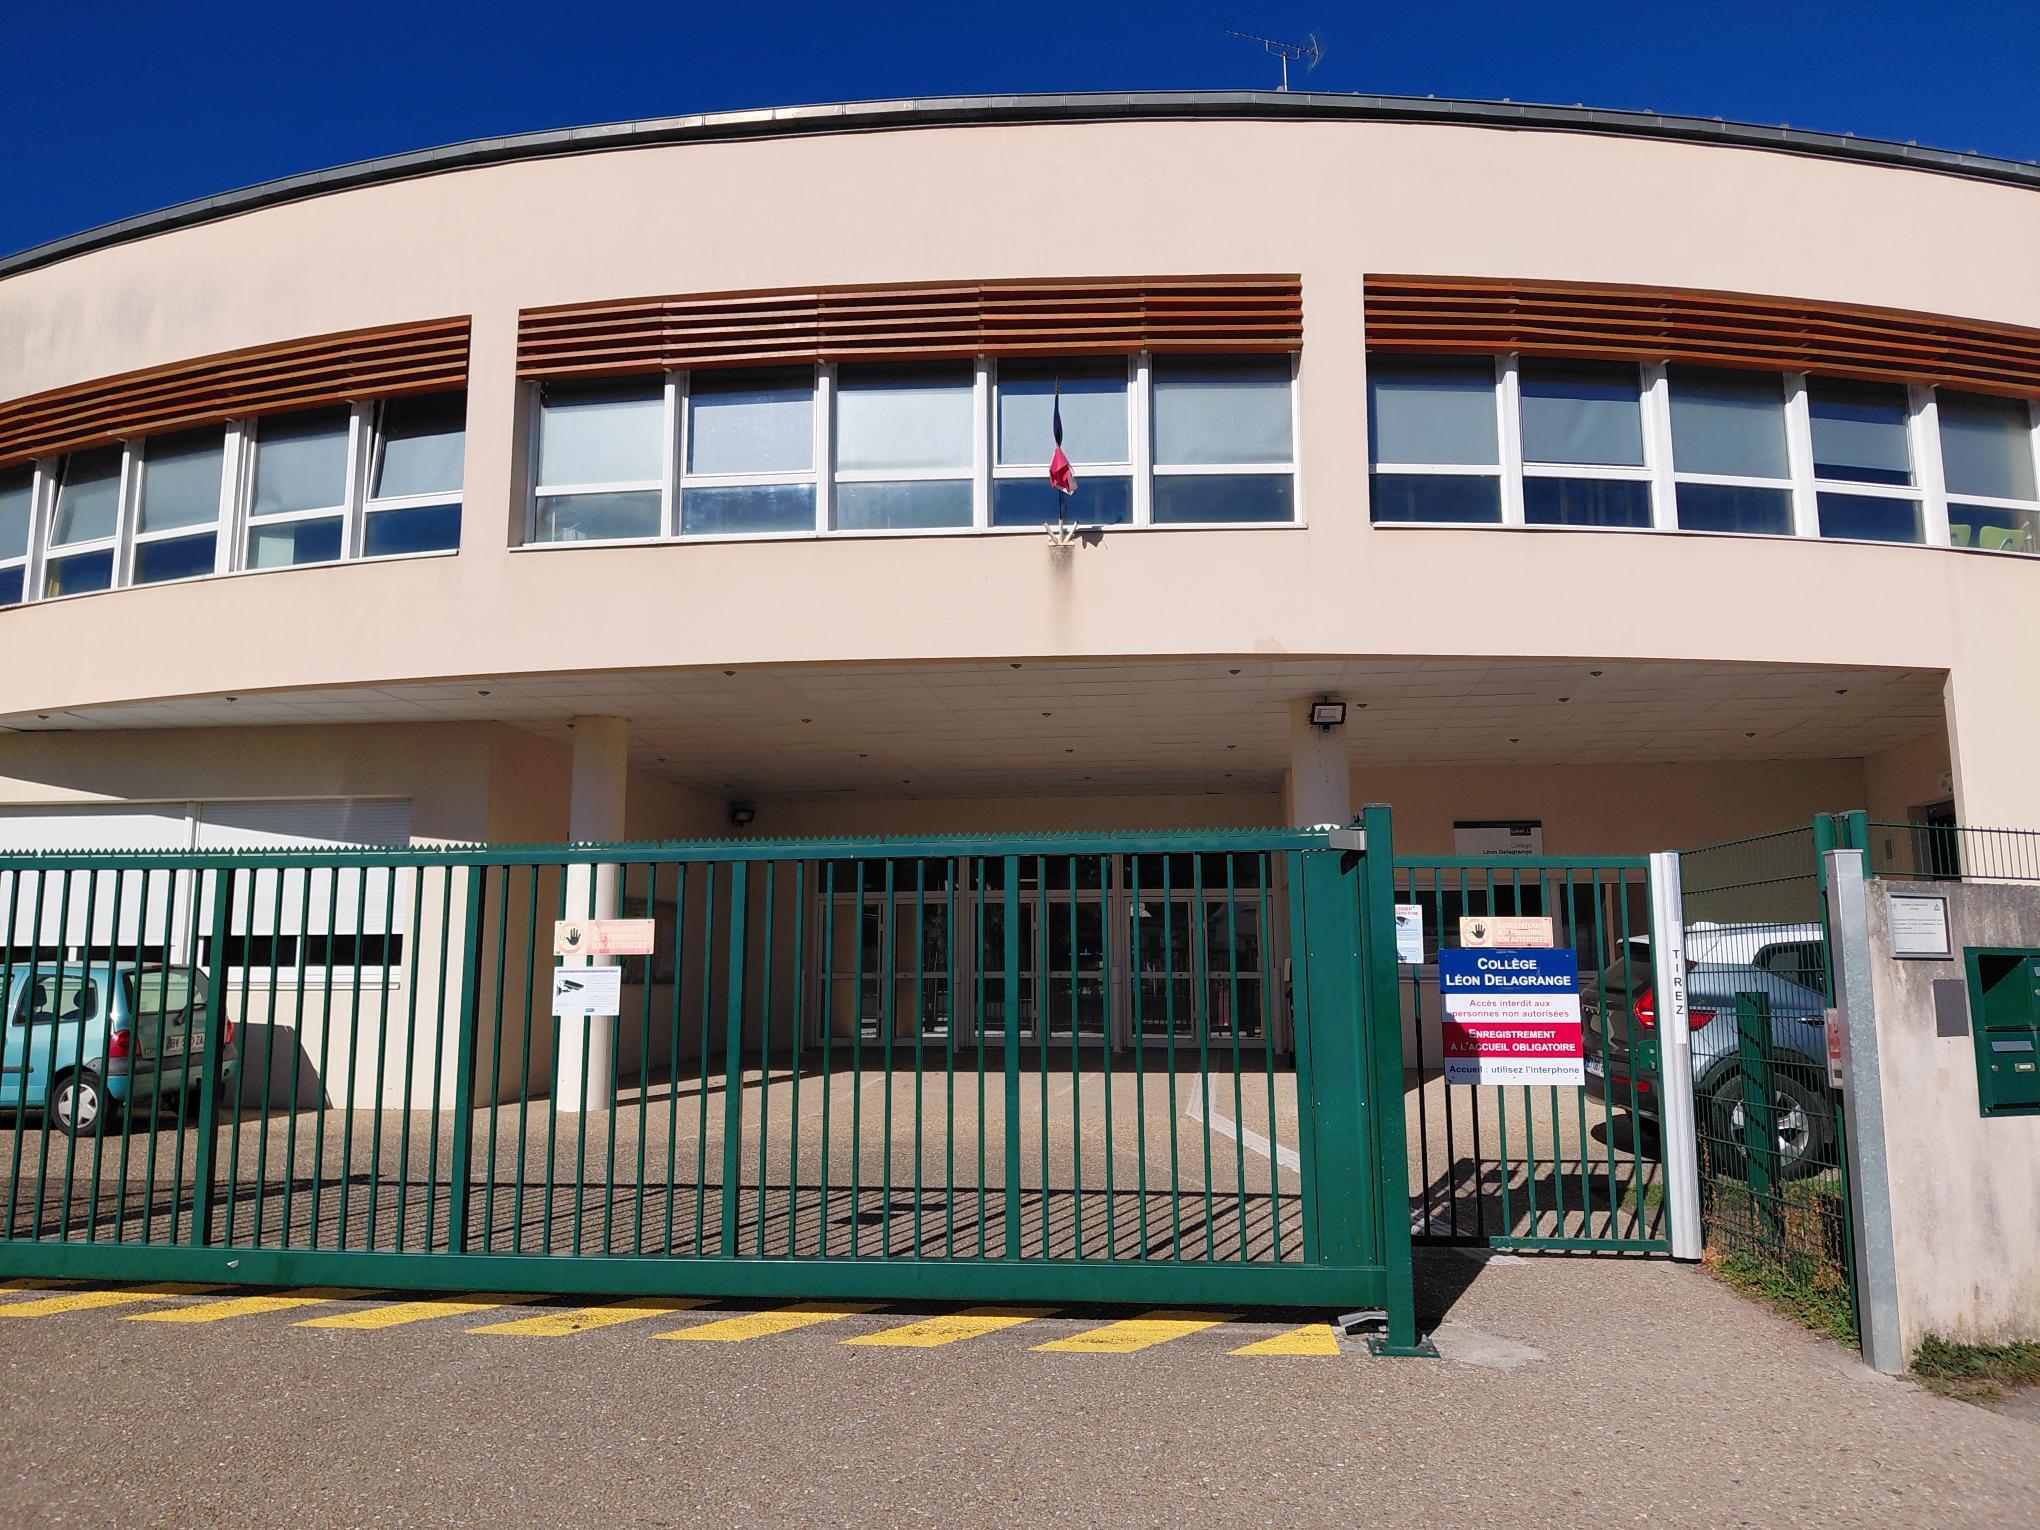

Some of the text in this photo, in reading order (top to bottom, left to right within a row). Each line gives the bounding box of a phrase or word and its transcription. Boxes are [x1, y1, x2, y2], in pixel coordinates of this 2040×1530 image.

[1484, 974, 1572, 986] DELAGRANGE
[1672, 949, 1684, 1014] TIREZ
[1469, 999, 1497, 1007] Accès
[1499, 999, 1531, 1007] interdit
[1452, 1010, 1500, 1018] personnes
[1522, 1009, 1570, 1017] autorisées
[1468, 1029, 1556, 1039] ENREGISTREMENT
[1512, 1043, 1576, 1052] OBLIGATOIRE
[1449, 1065, 1482, 1073] Accueil
[1491, 1065, 1523, 1074] utilisez
[1525, 1065, 1580, 1075] l'interphone
